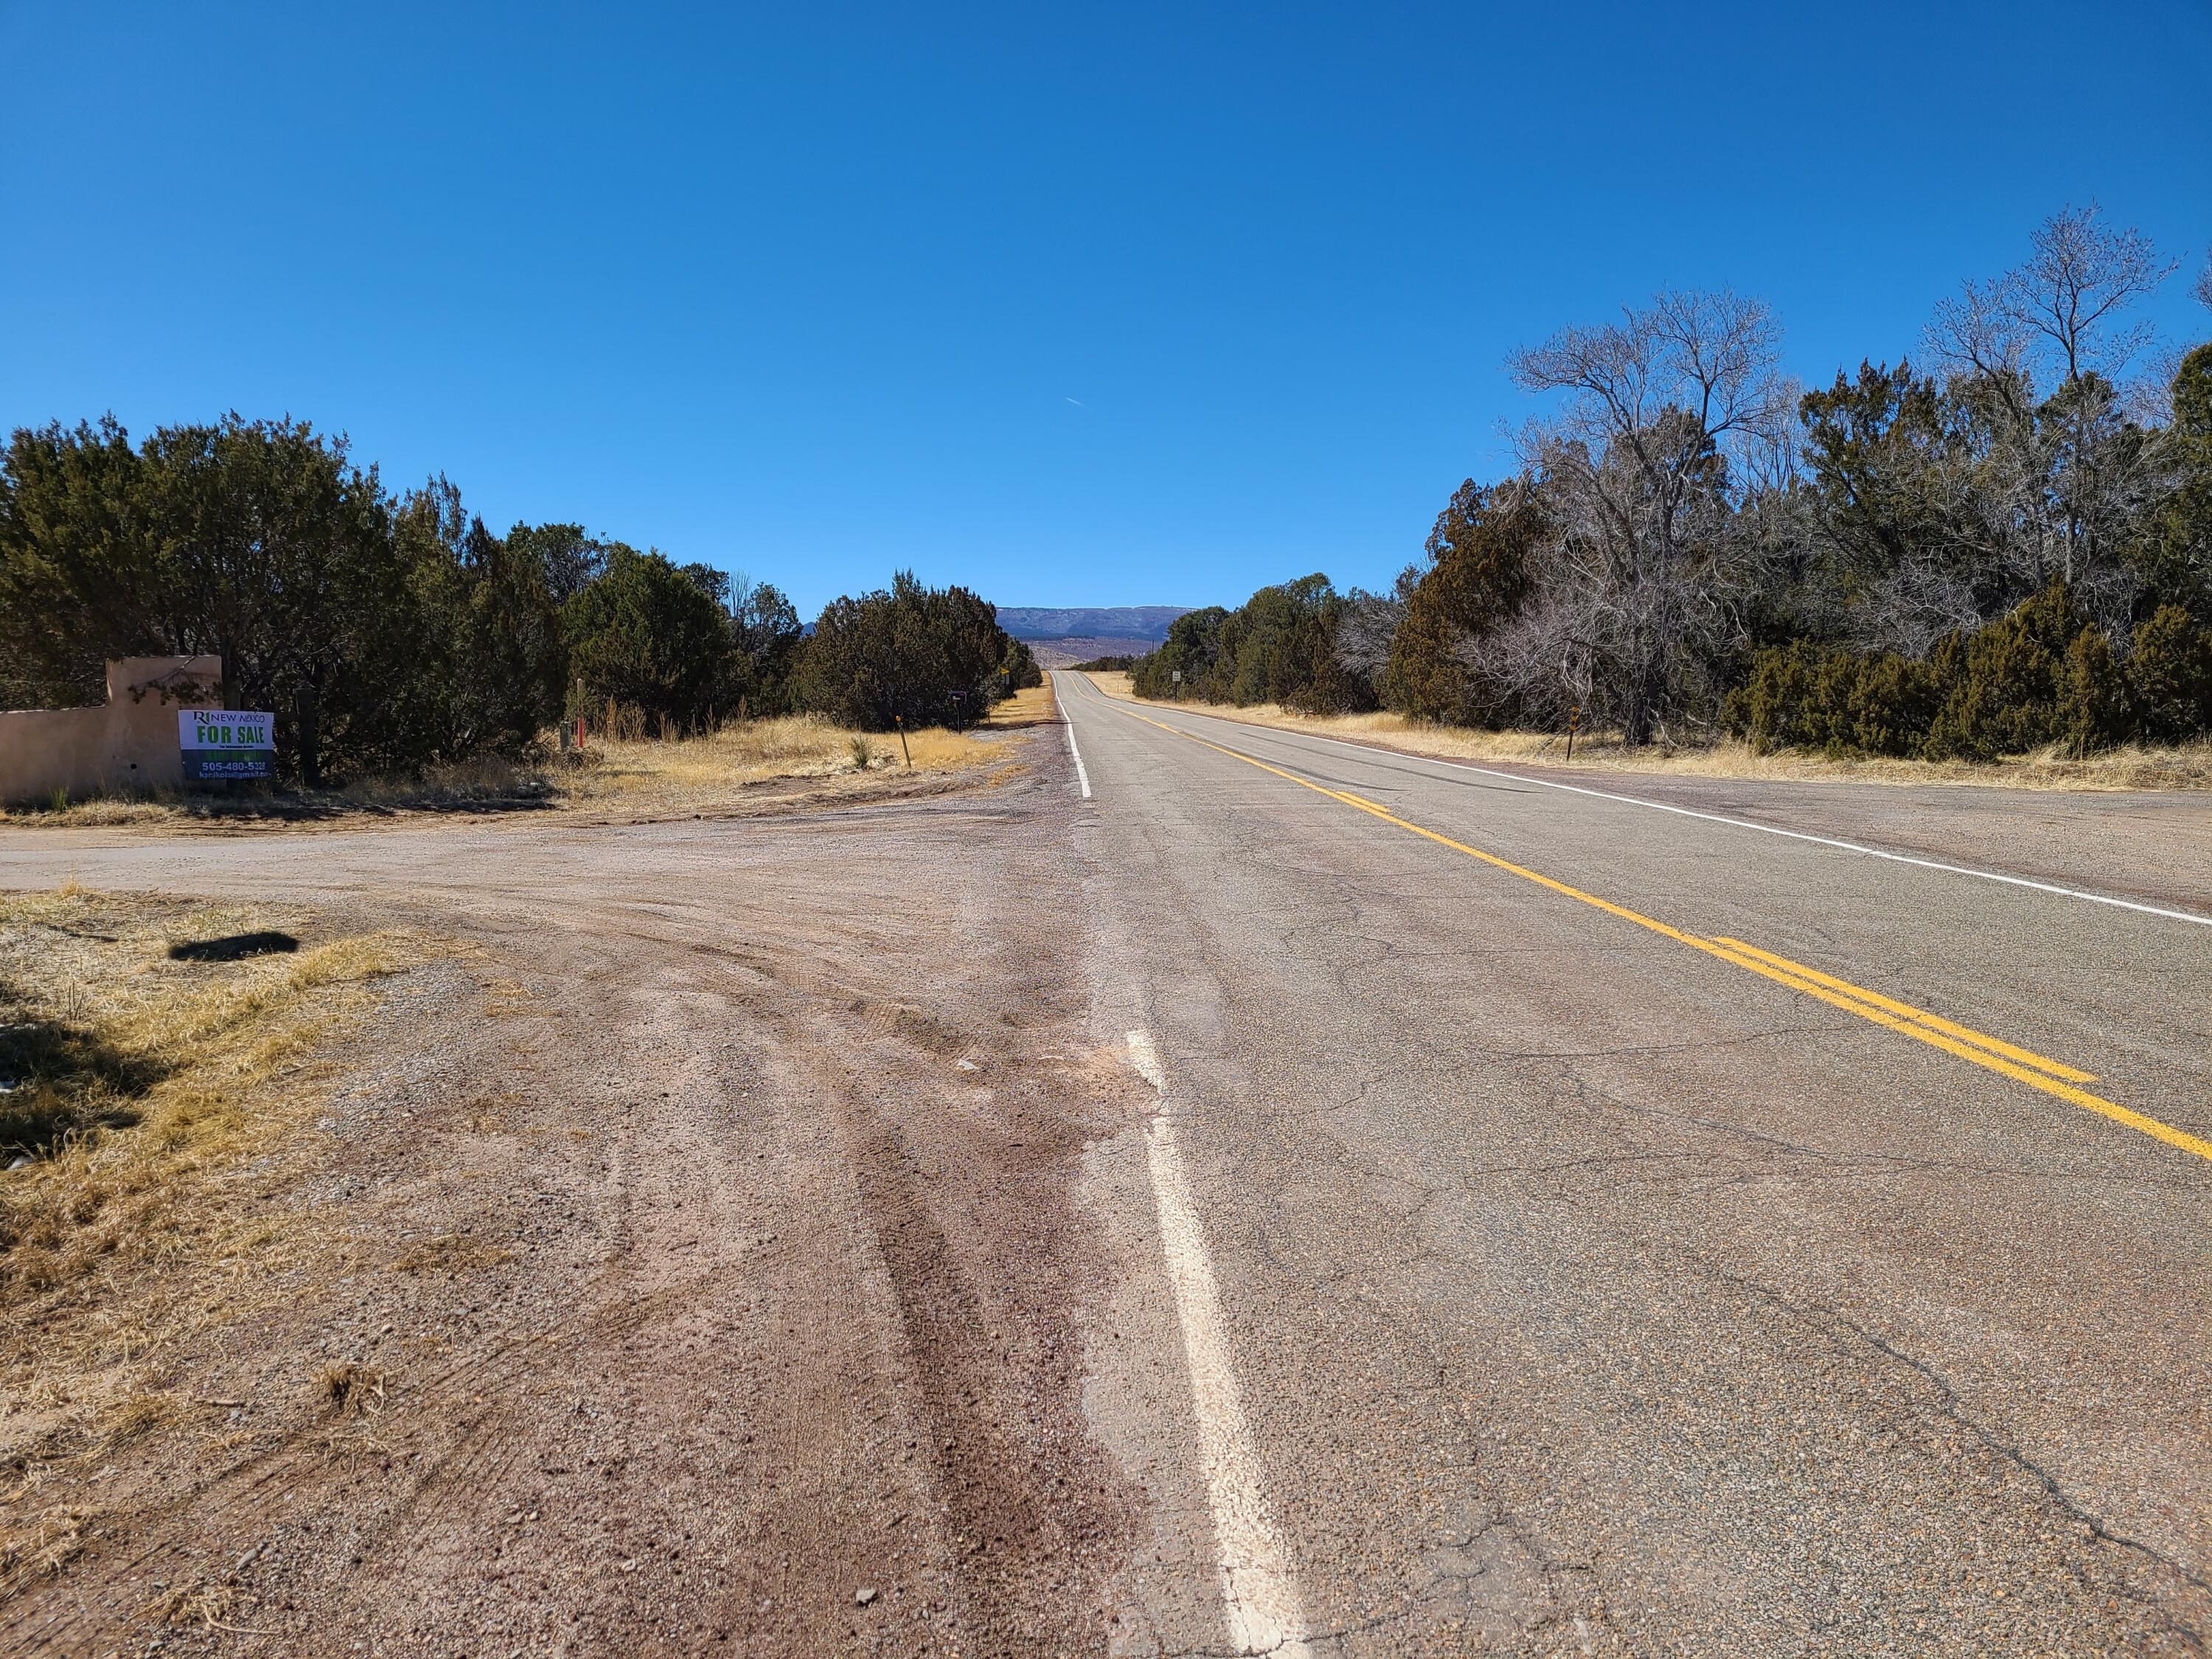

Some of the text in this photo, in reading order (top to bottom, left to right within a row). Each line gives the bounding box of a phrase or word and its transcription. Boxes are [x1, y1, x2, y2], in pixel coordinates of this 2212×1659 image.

[240, 715, 265, 723] MEXICO
[197, 726, 264, 743] FOR SALE
